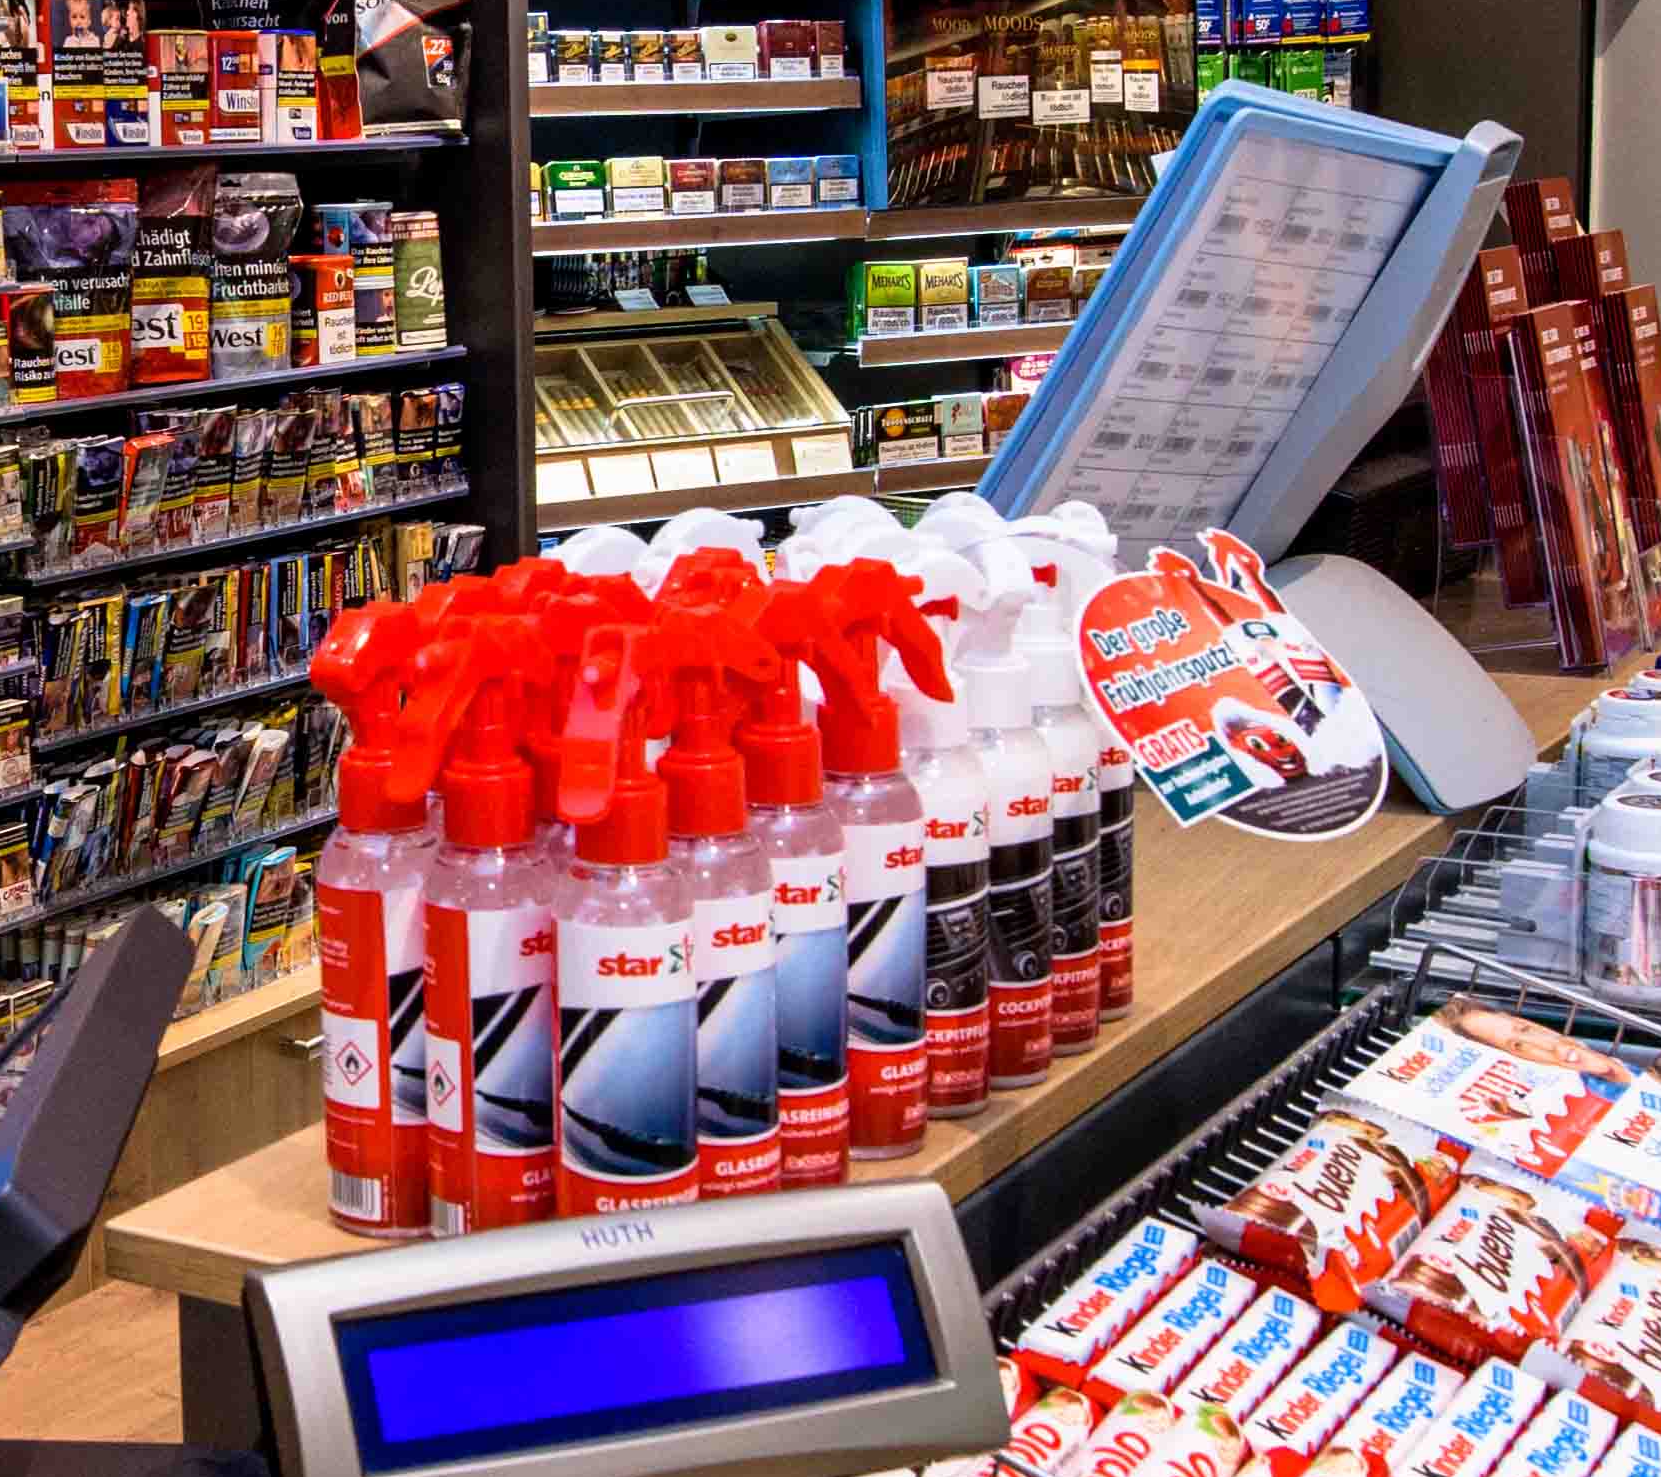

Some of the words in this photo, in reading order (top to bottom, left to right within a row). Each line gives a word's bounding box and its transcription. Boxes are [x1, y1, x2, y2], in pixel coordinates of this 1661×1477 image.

[1092, 627, 1128, 656] Der
[1131, 610, 1188, 651] große
[1138, 722, 1206, 768] GRATIS
[711, 921, 767, 949] star
[597, 954, 663, 977] star
[1292, 1139, 1363, 1214] bueno
[580, 1222, 655, 1249] HUTH
[1455, 1211, 1517, 1294] bueno
[1095, 1243, 1157, 1293] Riegel
[1163, 1284, 1226, 1332] Riegel
